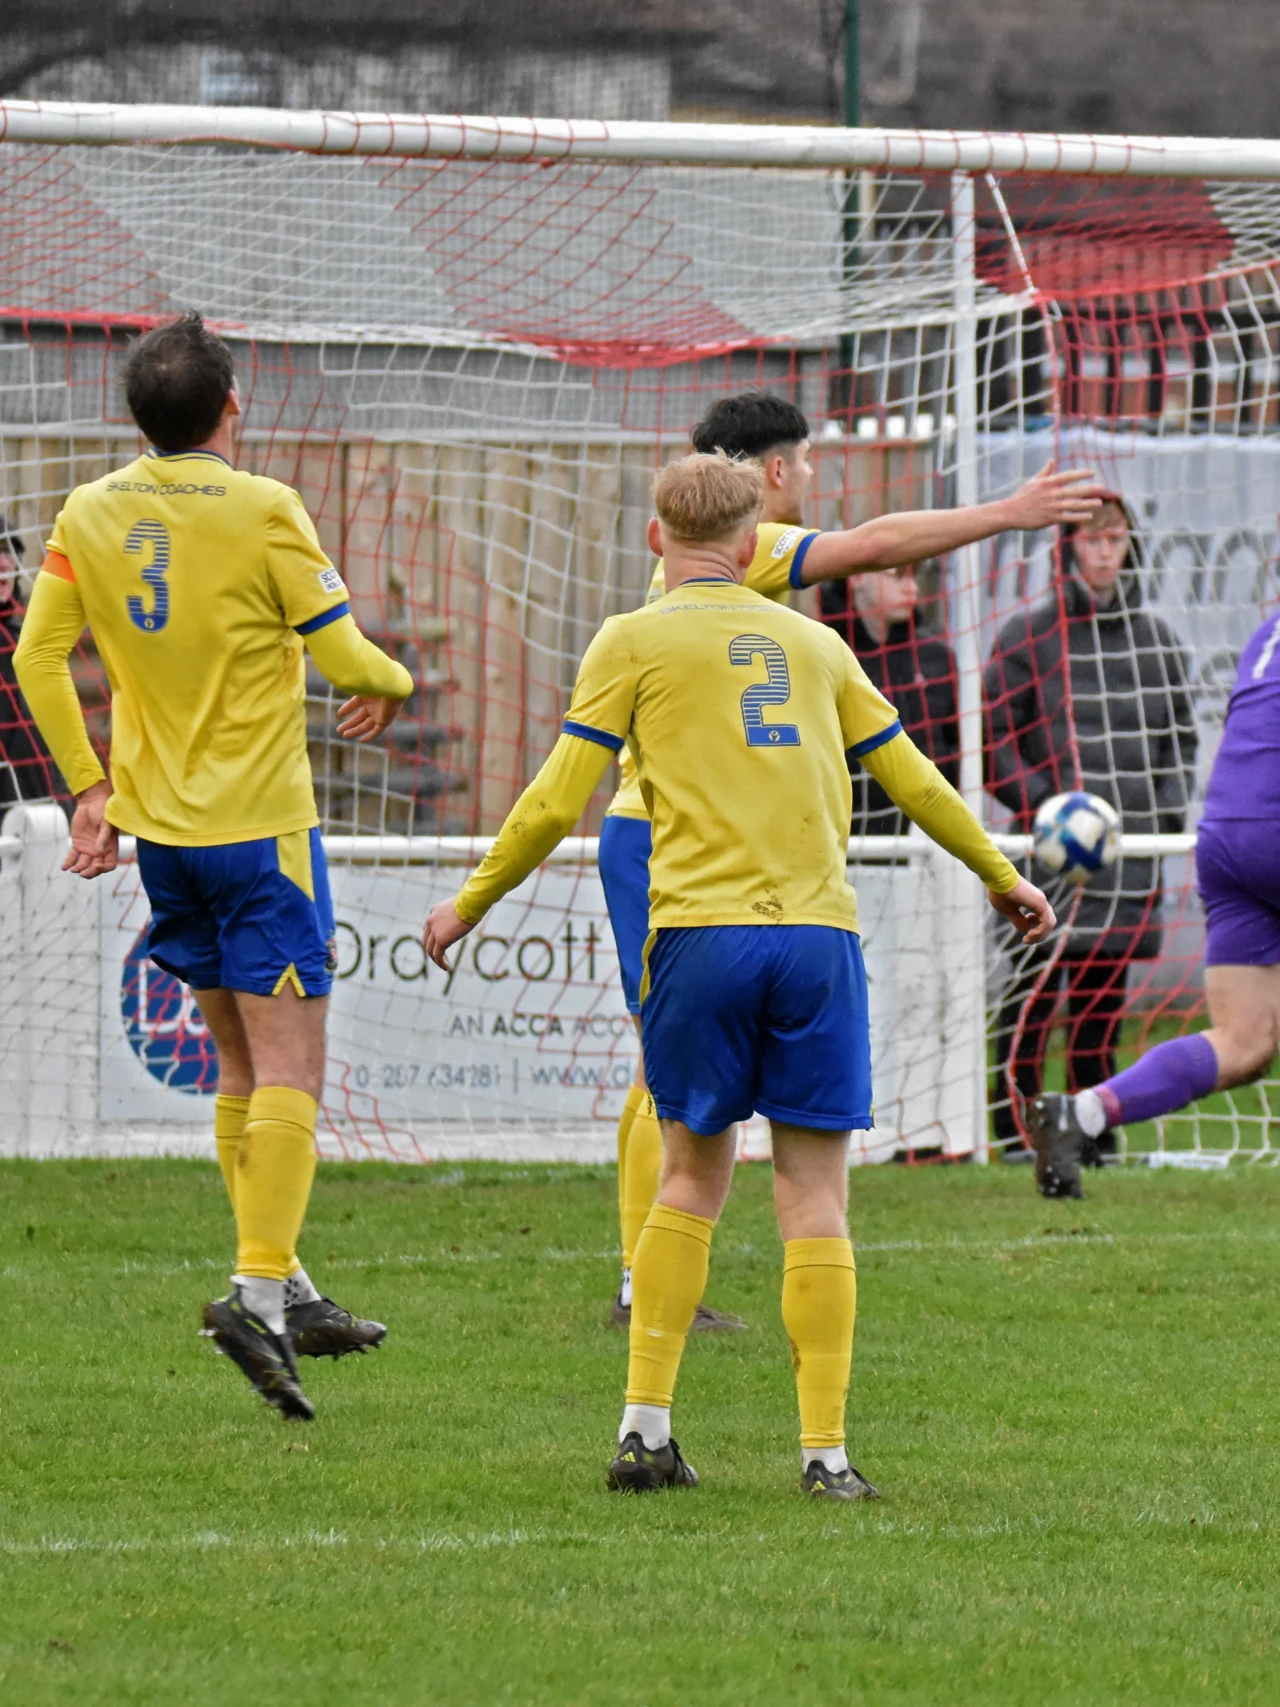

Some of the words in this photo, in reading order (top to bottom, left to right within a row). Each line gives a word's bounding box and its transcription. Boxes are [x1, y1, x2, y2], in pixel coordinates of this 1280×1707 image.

[106, 481, 158, 495] SKELTON
[159, 483, 226, 497] COACHES
[124, 518, 170, 633] 3
[729, 634, 801, 747] 2
[450, 1014, 484, 1036] AN
[492, 1013, 564, 1037] ACCA
